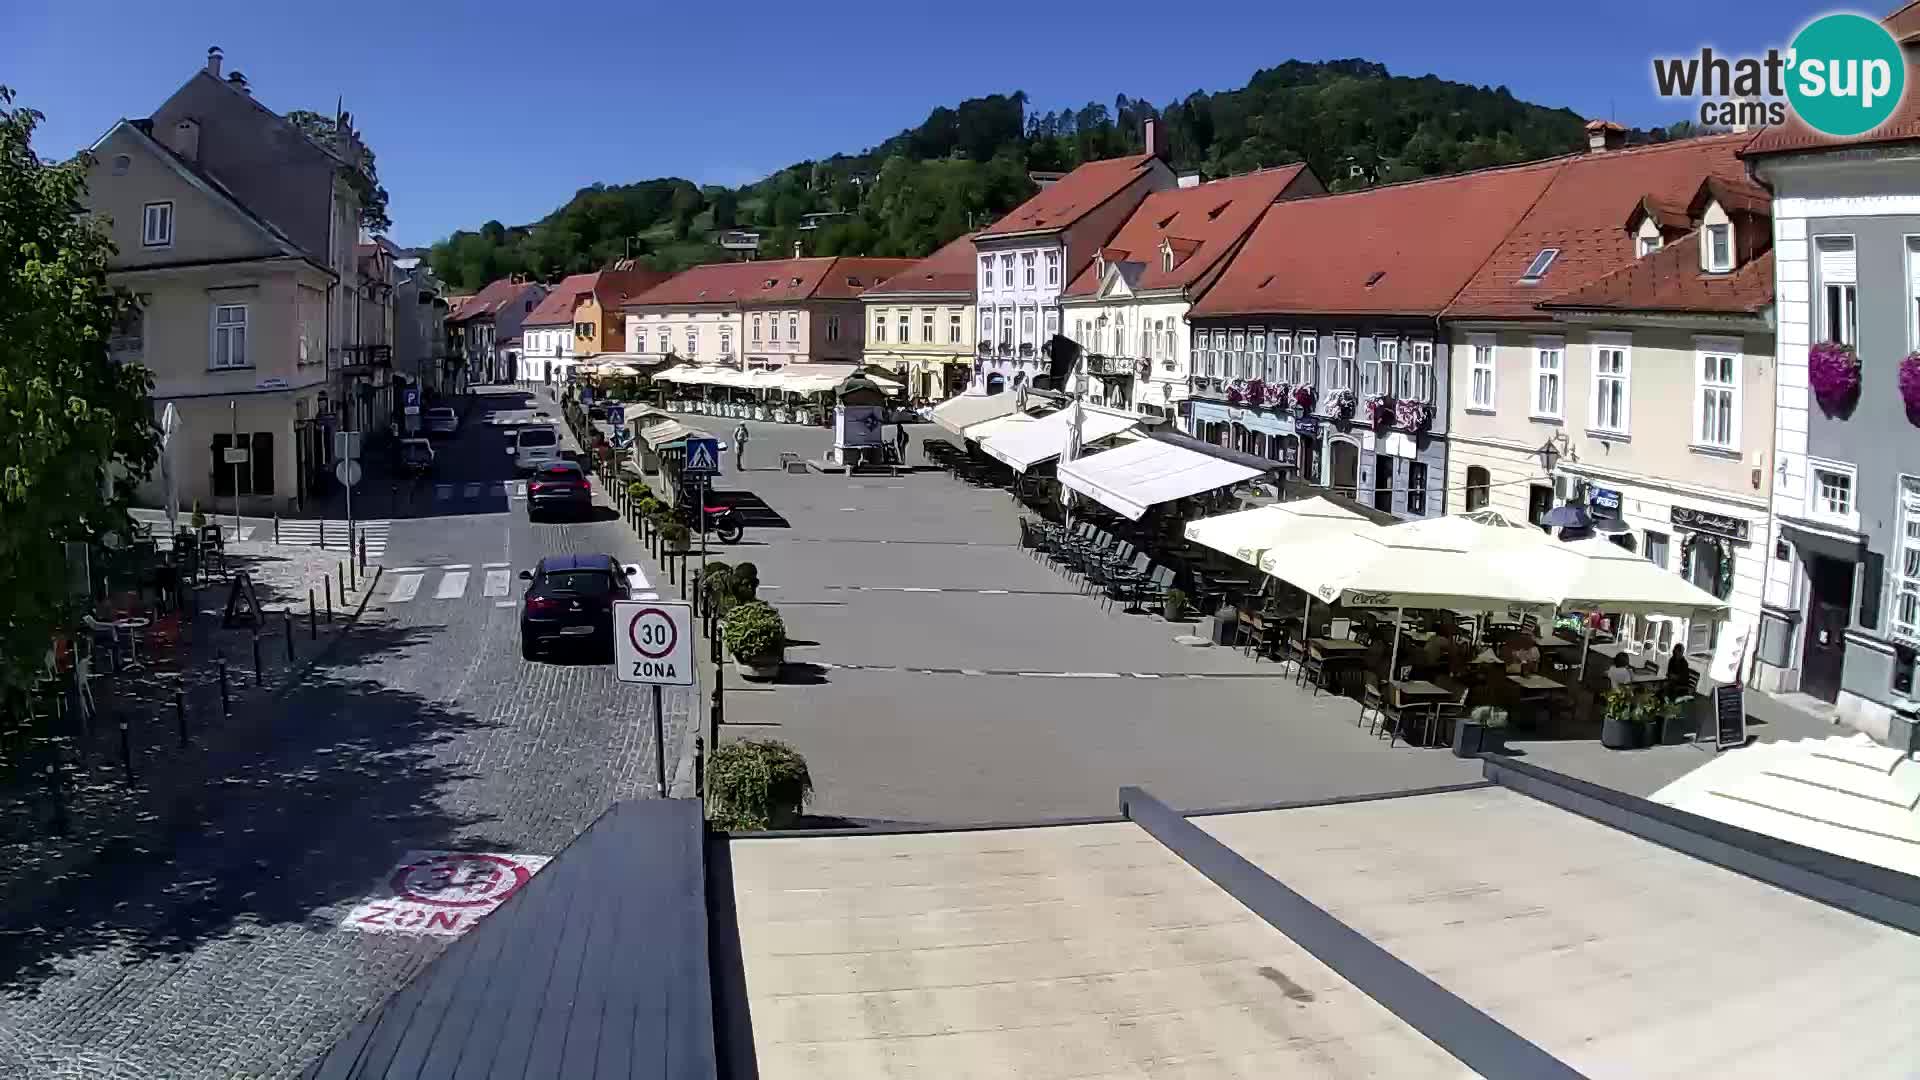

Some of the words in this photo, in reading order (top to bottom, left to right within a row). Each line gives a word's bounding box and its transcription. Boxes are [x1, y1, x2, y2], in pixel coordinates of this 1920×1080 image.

[642, 624, 666, 645] 30
[633, 661, 677, 678] ZONA
[358, 905, 476, 932] ZON
